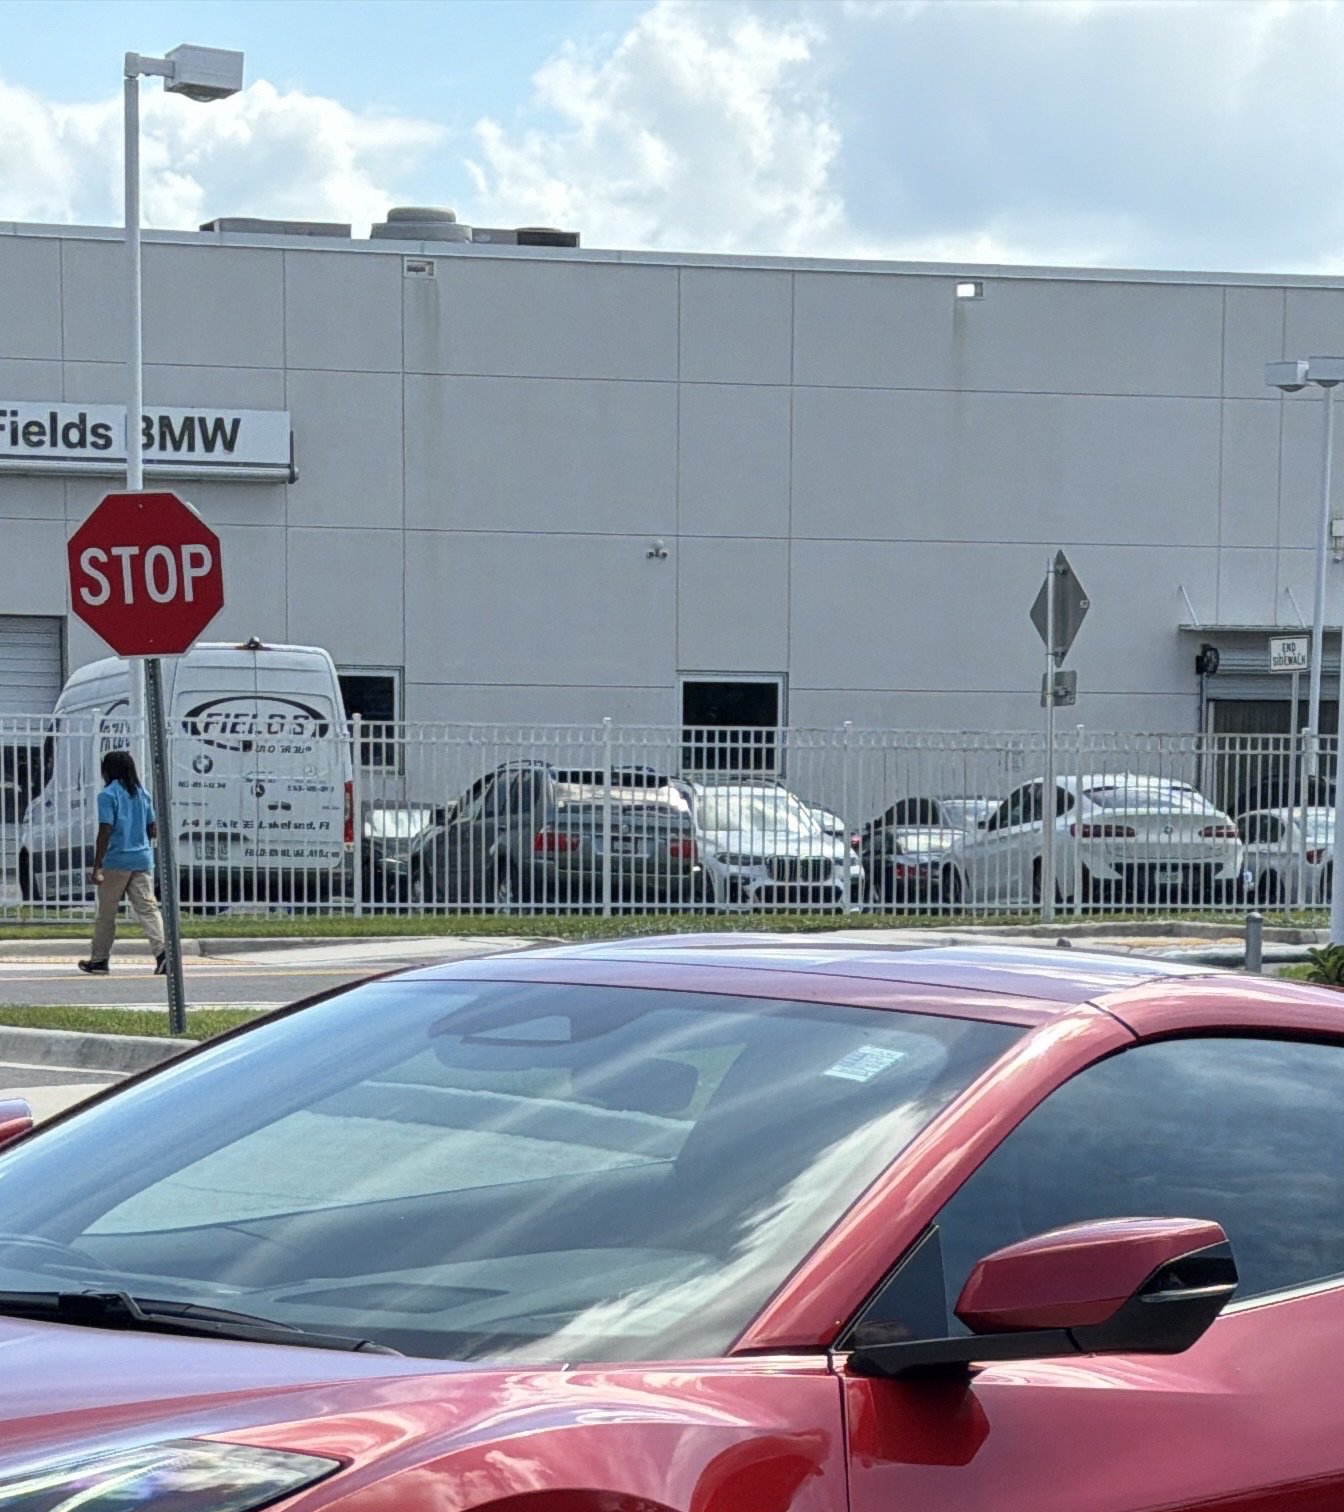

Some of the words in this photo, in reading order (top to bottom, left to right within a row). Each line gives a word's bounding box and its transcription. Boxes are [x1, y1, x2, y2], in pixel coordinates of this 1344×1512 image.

[125, 413, 241, 454] BMW
[80, 543, 213, 606] STOP
[1281, 642, 1296, 652] END
